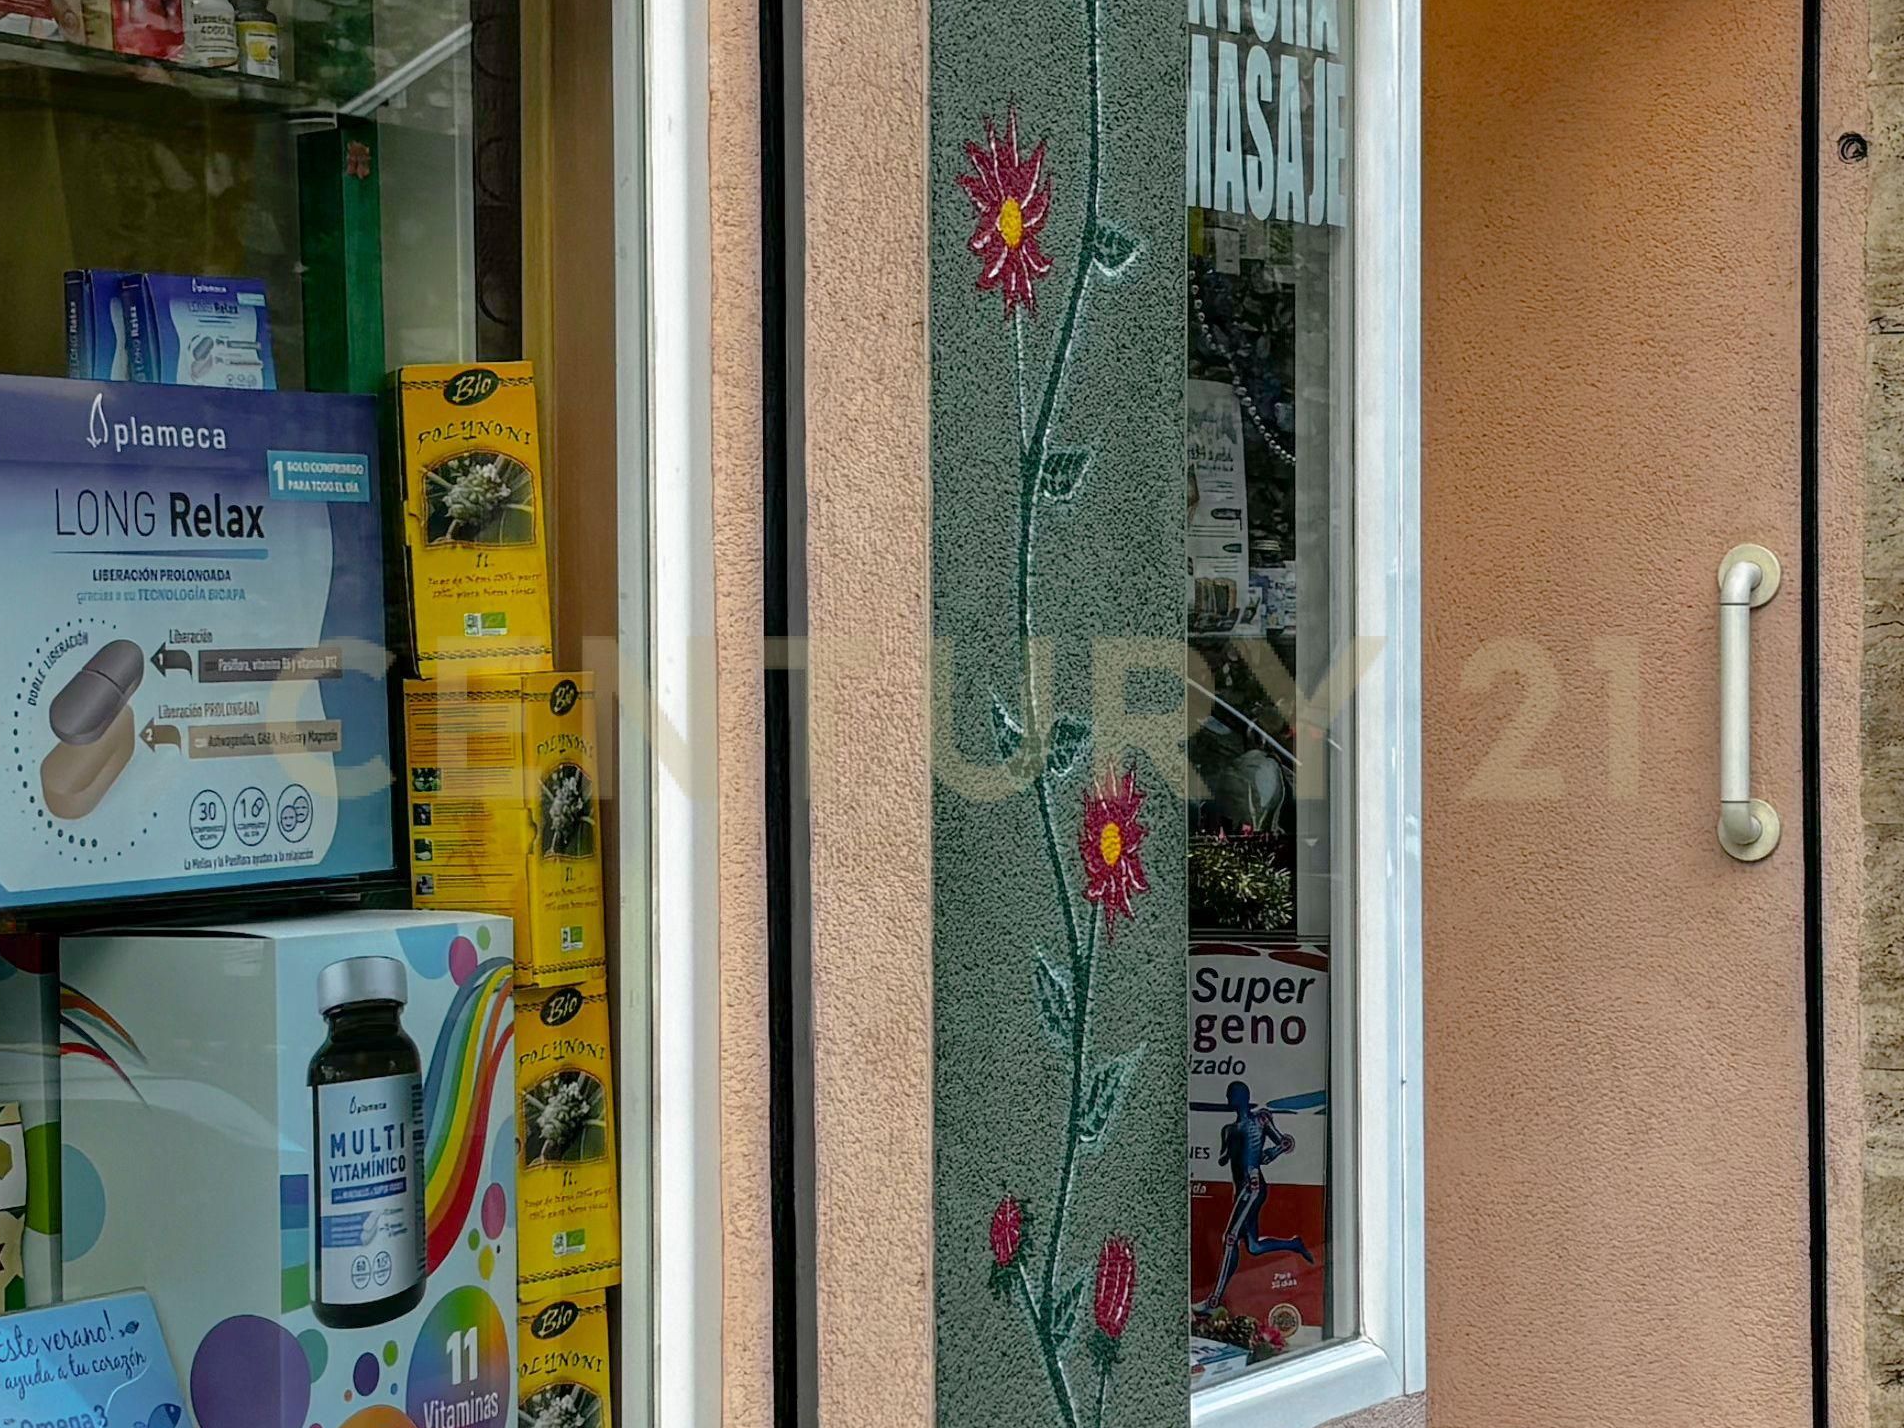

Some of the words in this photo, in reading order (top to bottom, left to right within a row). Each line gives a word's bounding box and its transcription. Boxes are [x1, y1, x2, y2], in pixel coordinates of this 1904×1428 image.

[451, 373, 492, 403] Bio
[114, 416, 227, 453] plameca
[416, 418, 532, 455] POLYNONI
[273, 460, 285, 491] 1
[55, 488, 156, 537] LONG
[169, 491, 265, 539] Relax
[92, 568, 158, 582] LIBERACIÓN
[159, 569, 232, 582] PROLONGADA
[137, 585, 206, 602] TECNOLOGÍA
[168, 628, 214, 645] Liberación
[158, 704, 202, 720] Liberación
[199, 801, 217, 821] 30
[1191, 967, 1316, 1013] Super
[545, 995, 578, 1023] Bio
[1194, 1013, 1308, 1054] geno
[519, 1037, 606, 1070] POLYNONI
[329, 1122, 406, 1160] MULTI
[329, 1154, 406, 1183] VITAMÍNICO
[40, 1309, 115, 1352] verano!
[538, 1304, 574, 1337] Bio
[446, 1327, 479, 1386] 11
[519, 1349, 604, 1378] OLYNONI
[4, 1358, 55, 1401] ayuda
[58, 1367, 69, 1379] a
[69, 1353, 91, 1377] tu
[91, 1346, 148, 1380] corazón
[93, 1404, 108, 1428] 3
